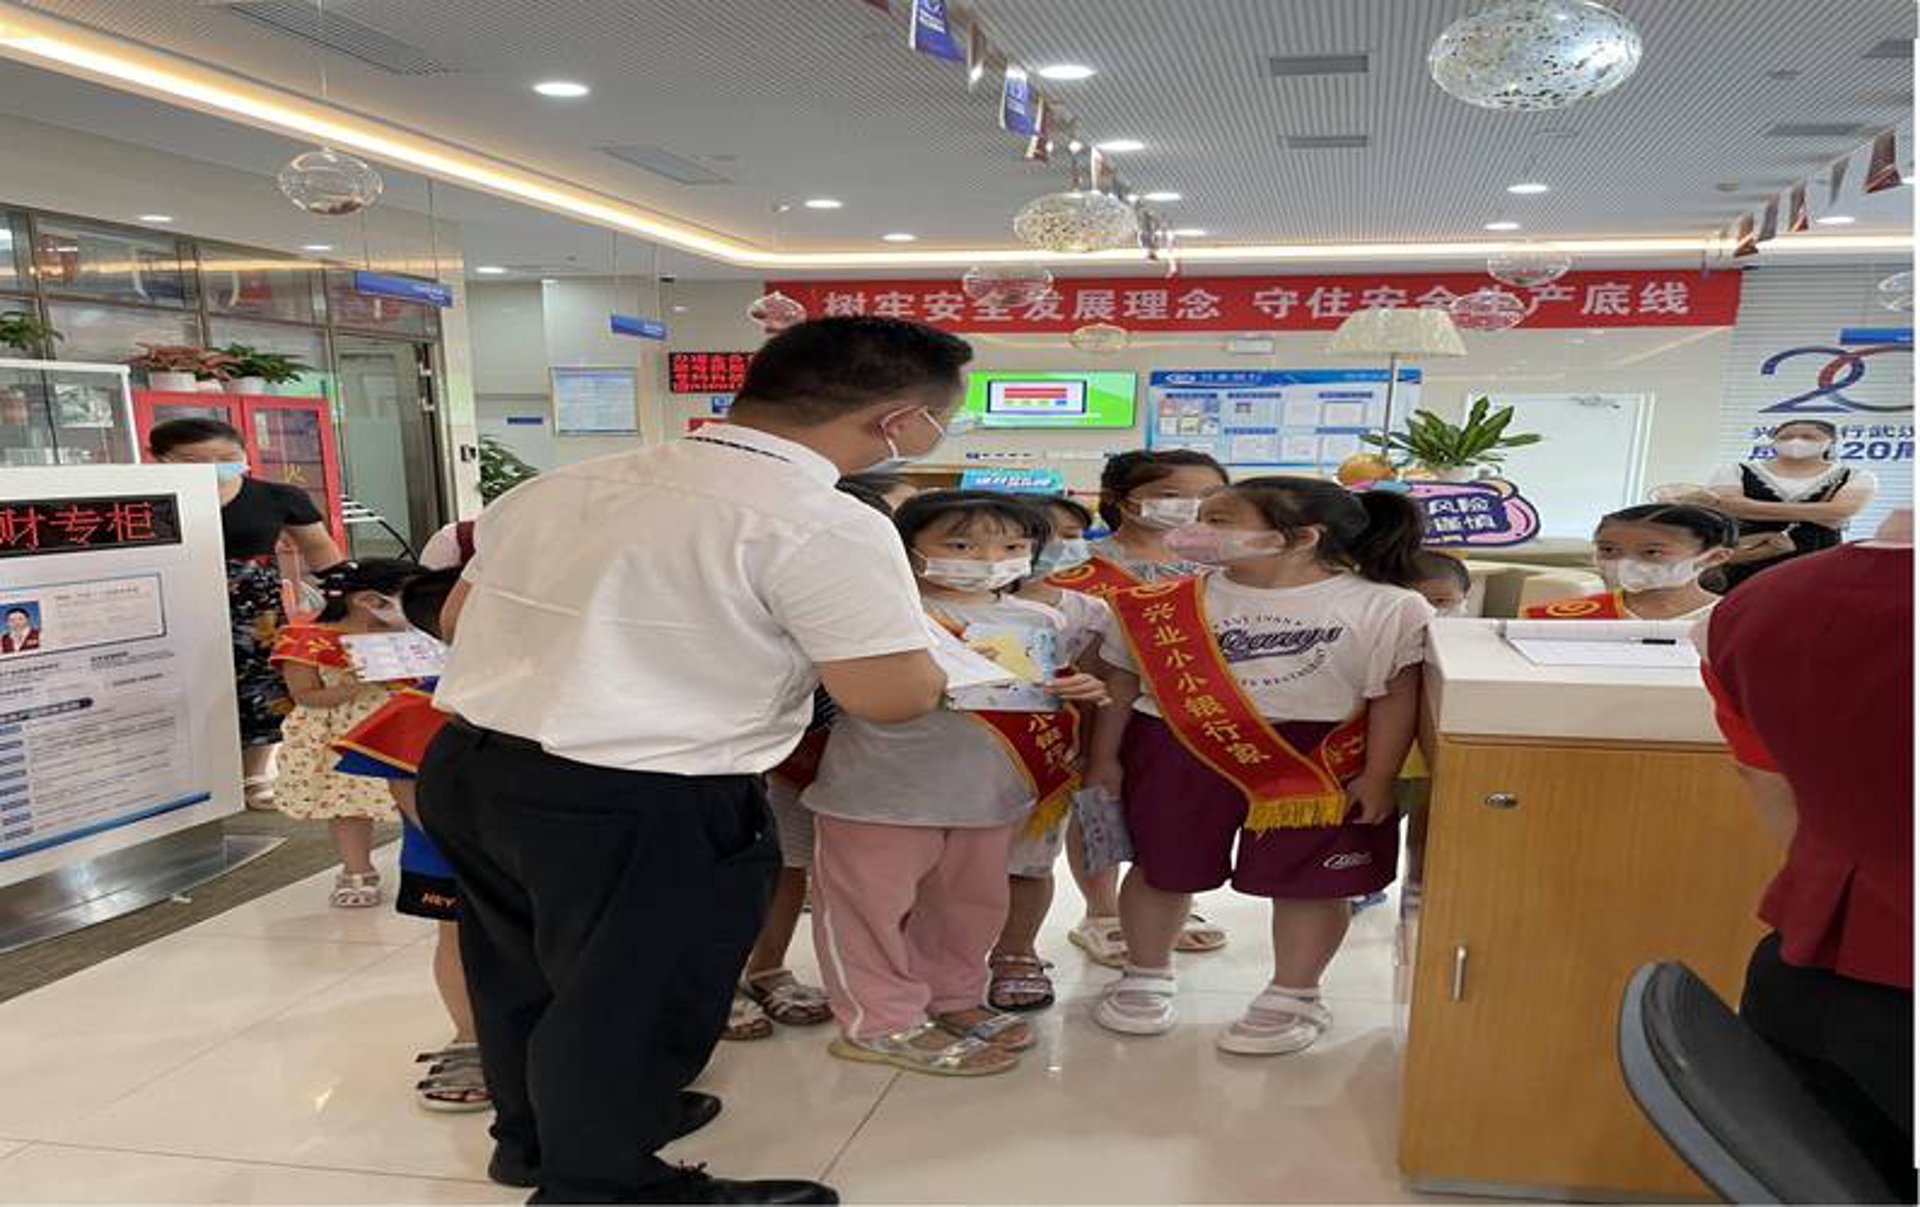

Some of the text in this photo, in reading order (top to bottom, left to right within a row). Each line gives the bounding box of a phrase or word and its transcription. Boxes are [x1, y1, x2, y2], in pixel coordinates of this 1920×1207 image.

[824, 288, 1222, 321] 树牢安全发展理念
[0, 500, 155, 550] 财专柜
[1141, 602, 1272, 765] 兴业小小银行家
